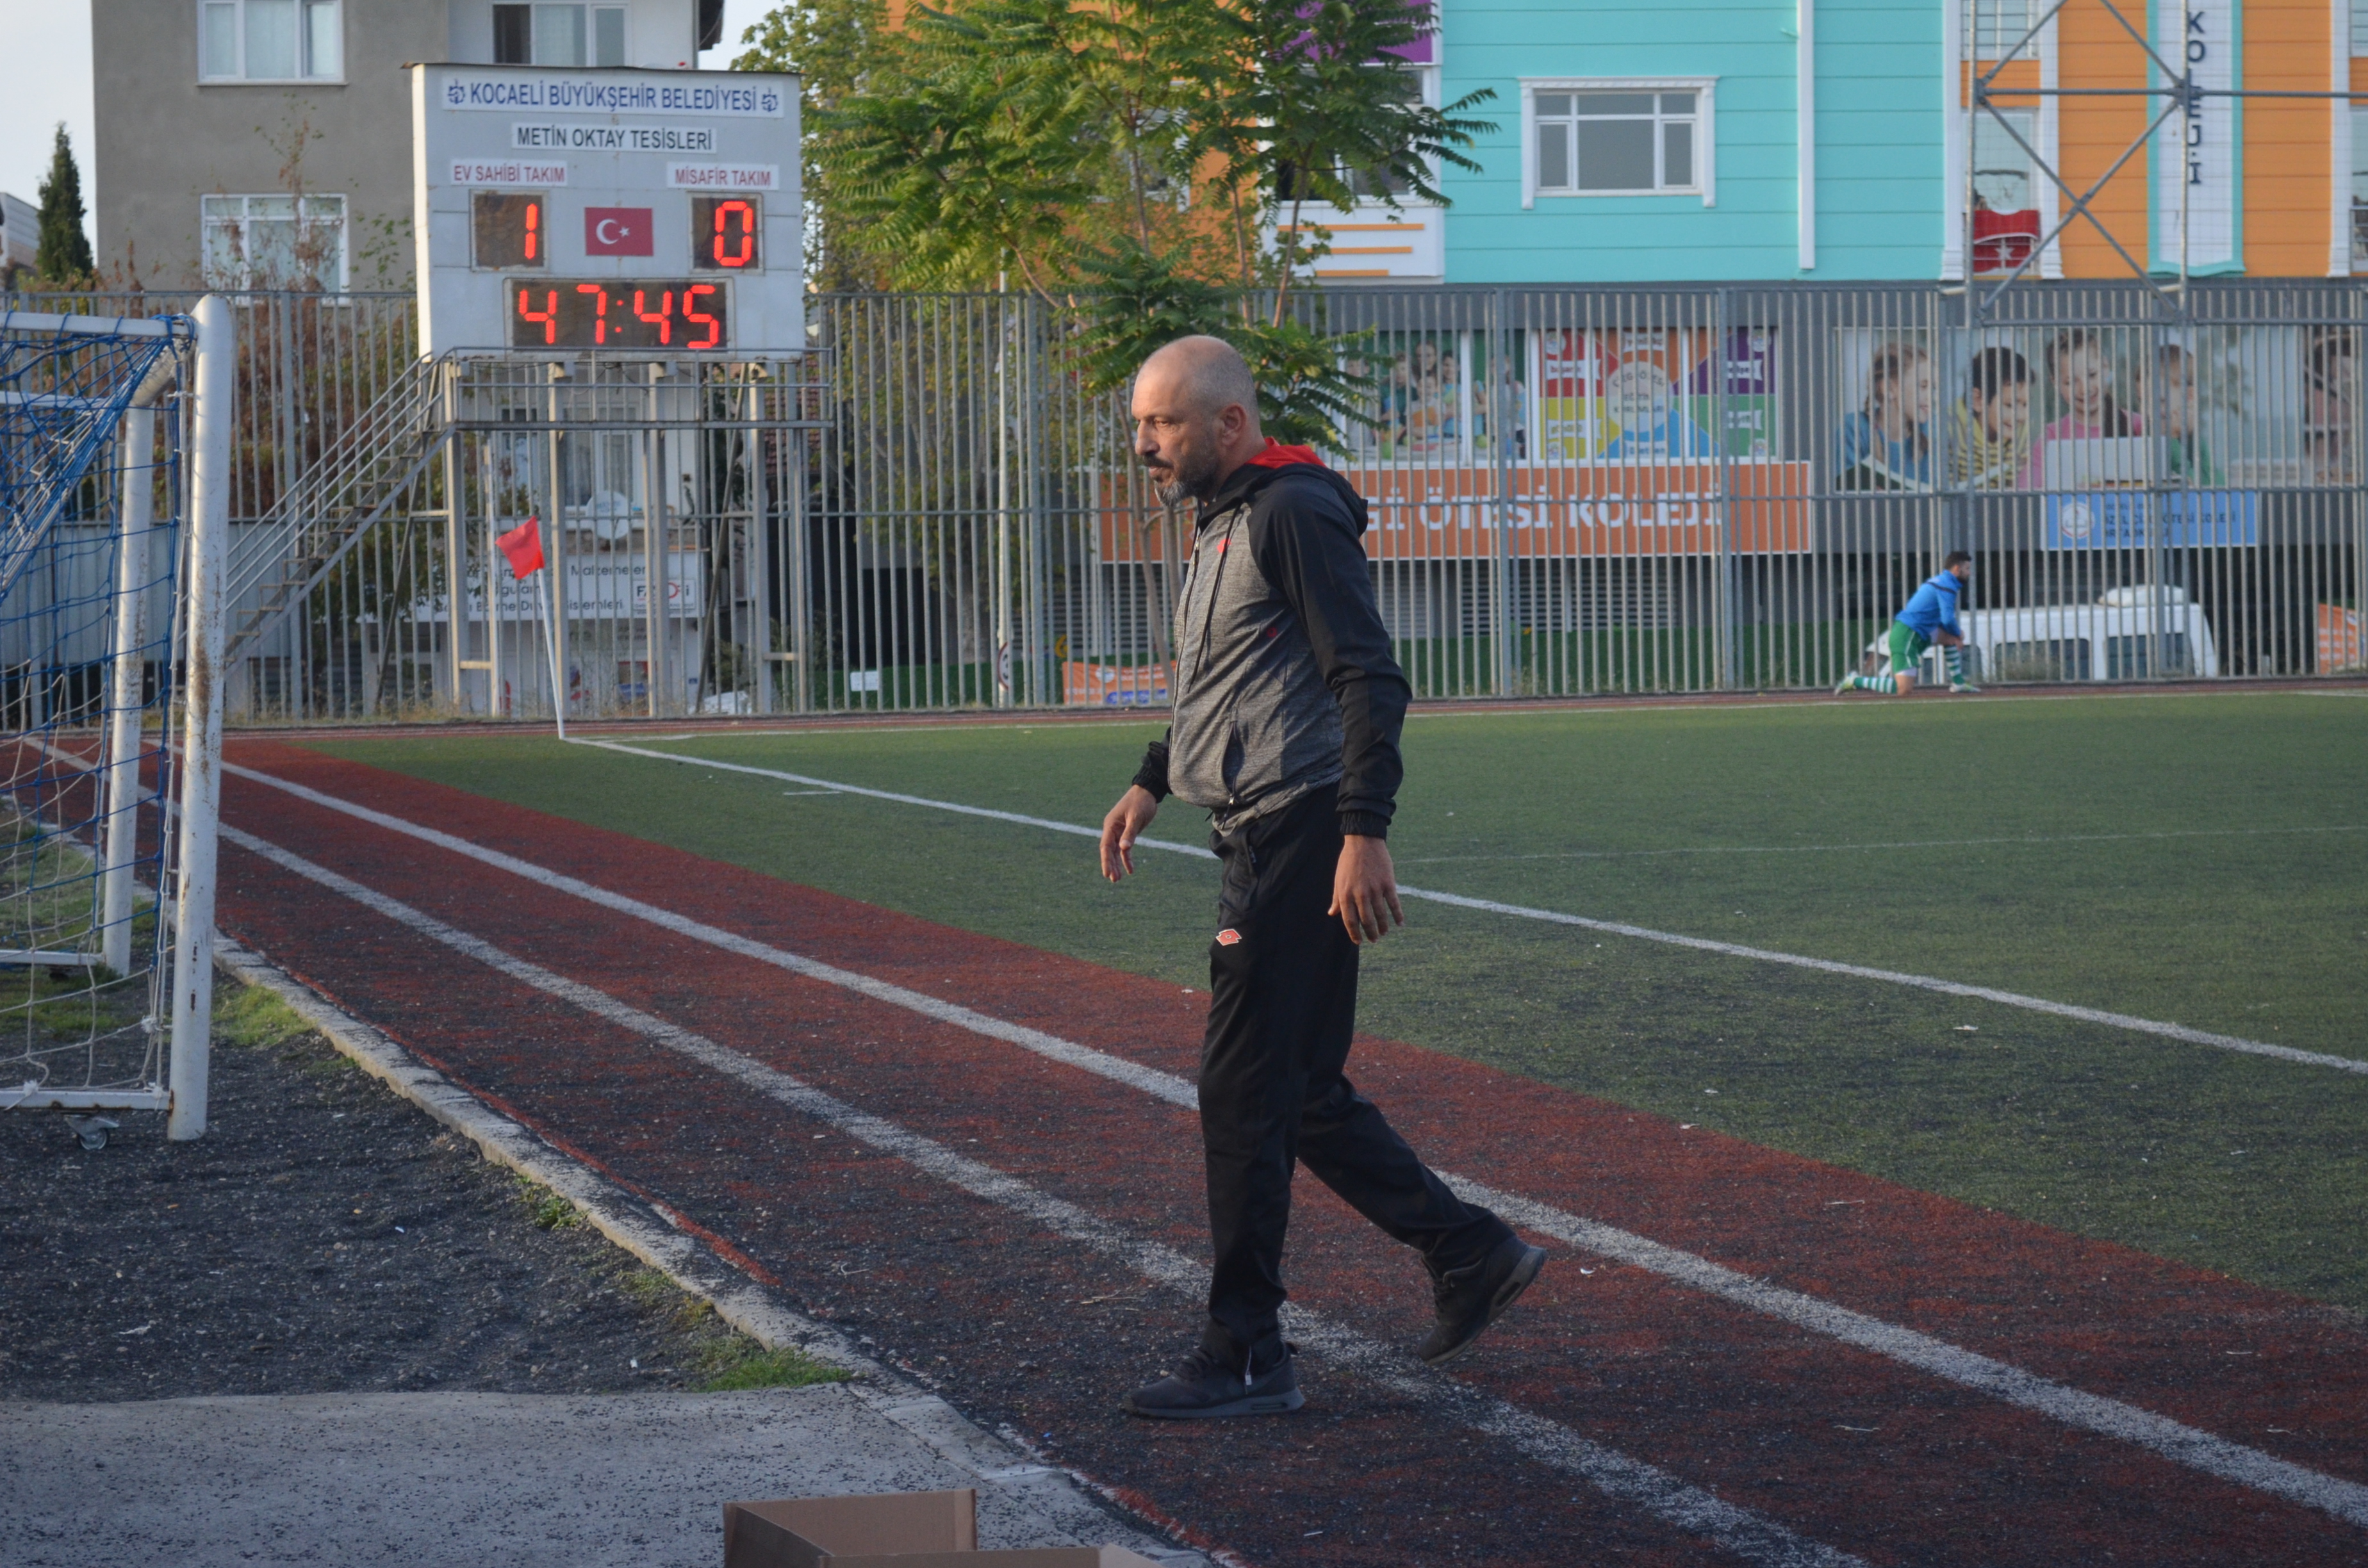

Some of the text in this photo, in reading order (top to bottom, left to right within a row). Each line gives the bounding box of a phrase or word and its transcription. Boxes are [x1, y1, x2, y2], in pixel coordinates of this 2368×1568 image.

[470, 79, 757, 113] KOCAELİ BÜYÜKŞEHİR BELEDİYESİ
[517, 124, 712, 151] METİN OKTAY TESİSLERİ
[453, 163, 565, 183] EV SAHİBİ TAKIM
[674, 165, 771, 186] MİSAFİR TAKIM
[525, 204, 538, 260] 1
[714, 200, 754, 267] 0
[518, 284, 720, 349] 47:45
